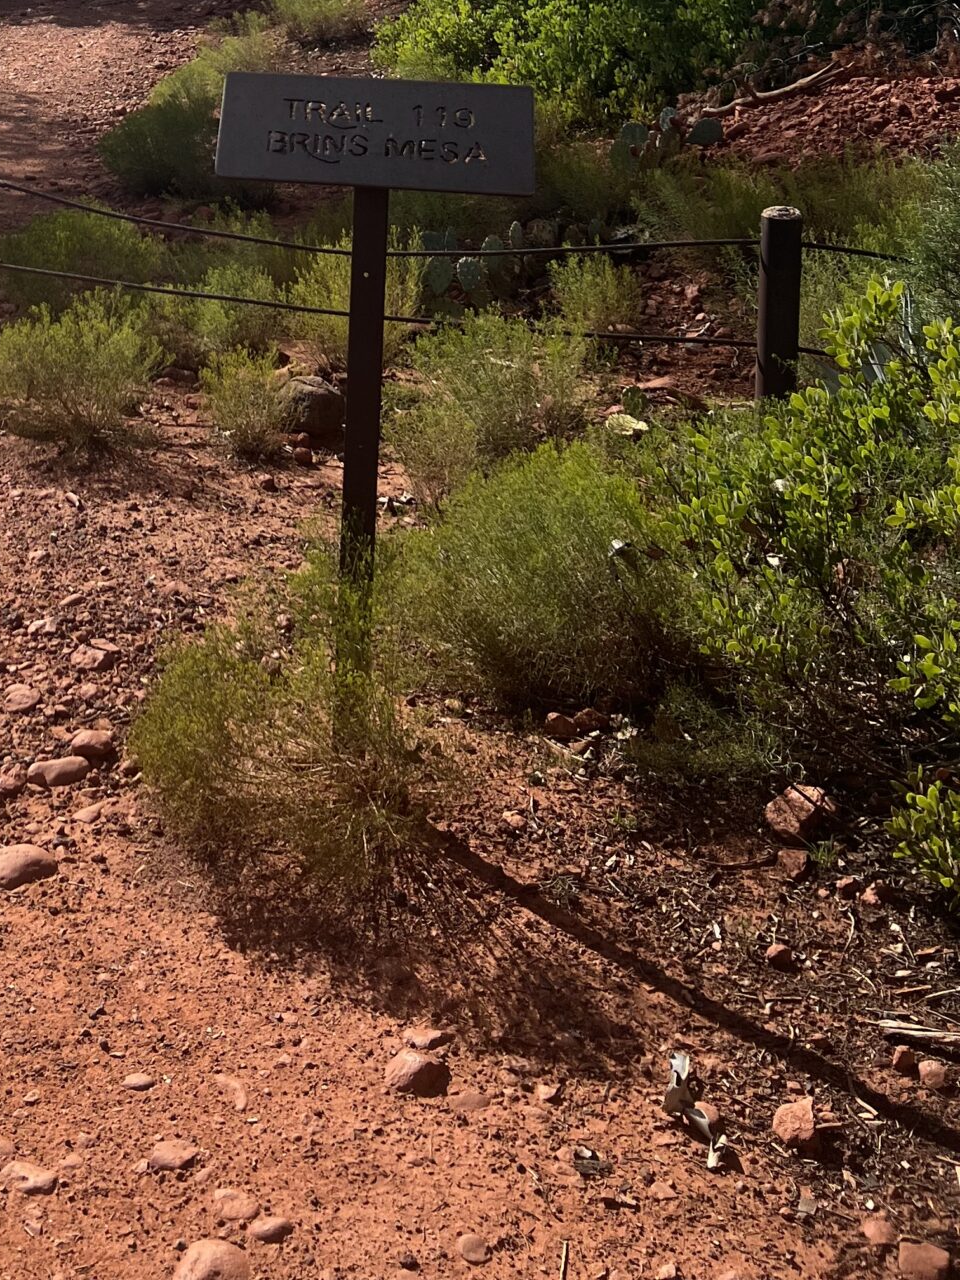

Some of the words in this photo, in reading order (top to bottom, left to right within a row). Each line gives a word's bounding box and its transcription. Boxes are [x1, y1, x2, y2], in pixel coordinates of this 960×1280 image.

[283, 98, 383, 129] TRAIL
[412, 104, 476, 129] 119
[266, 130, 368, 163] BRINS
[384, 137, 488, 164] MESA
